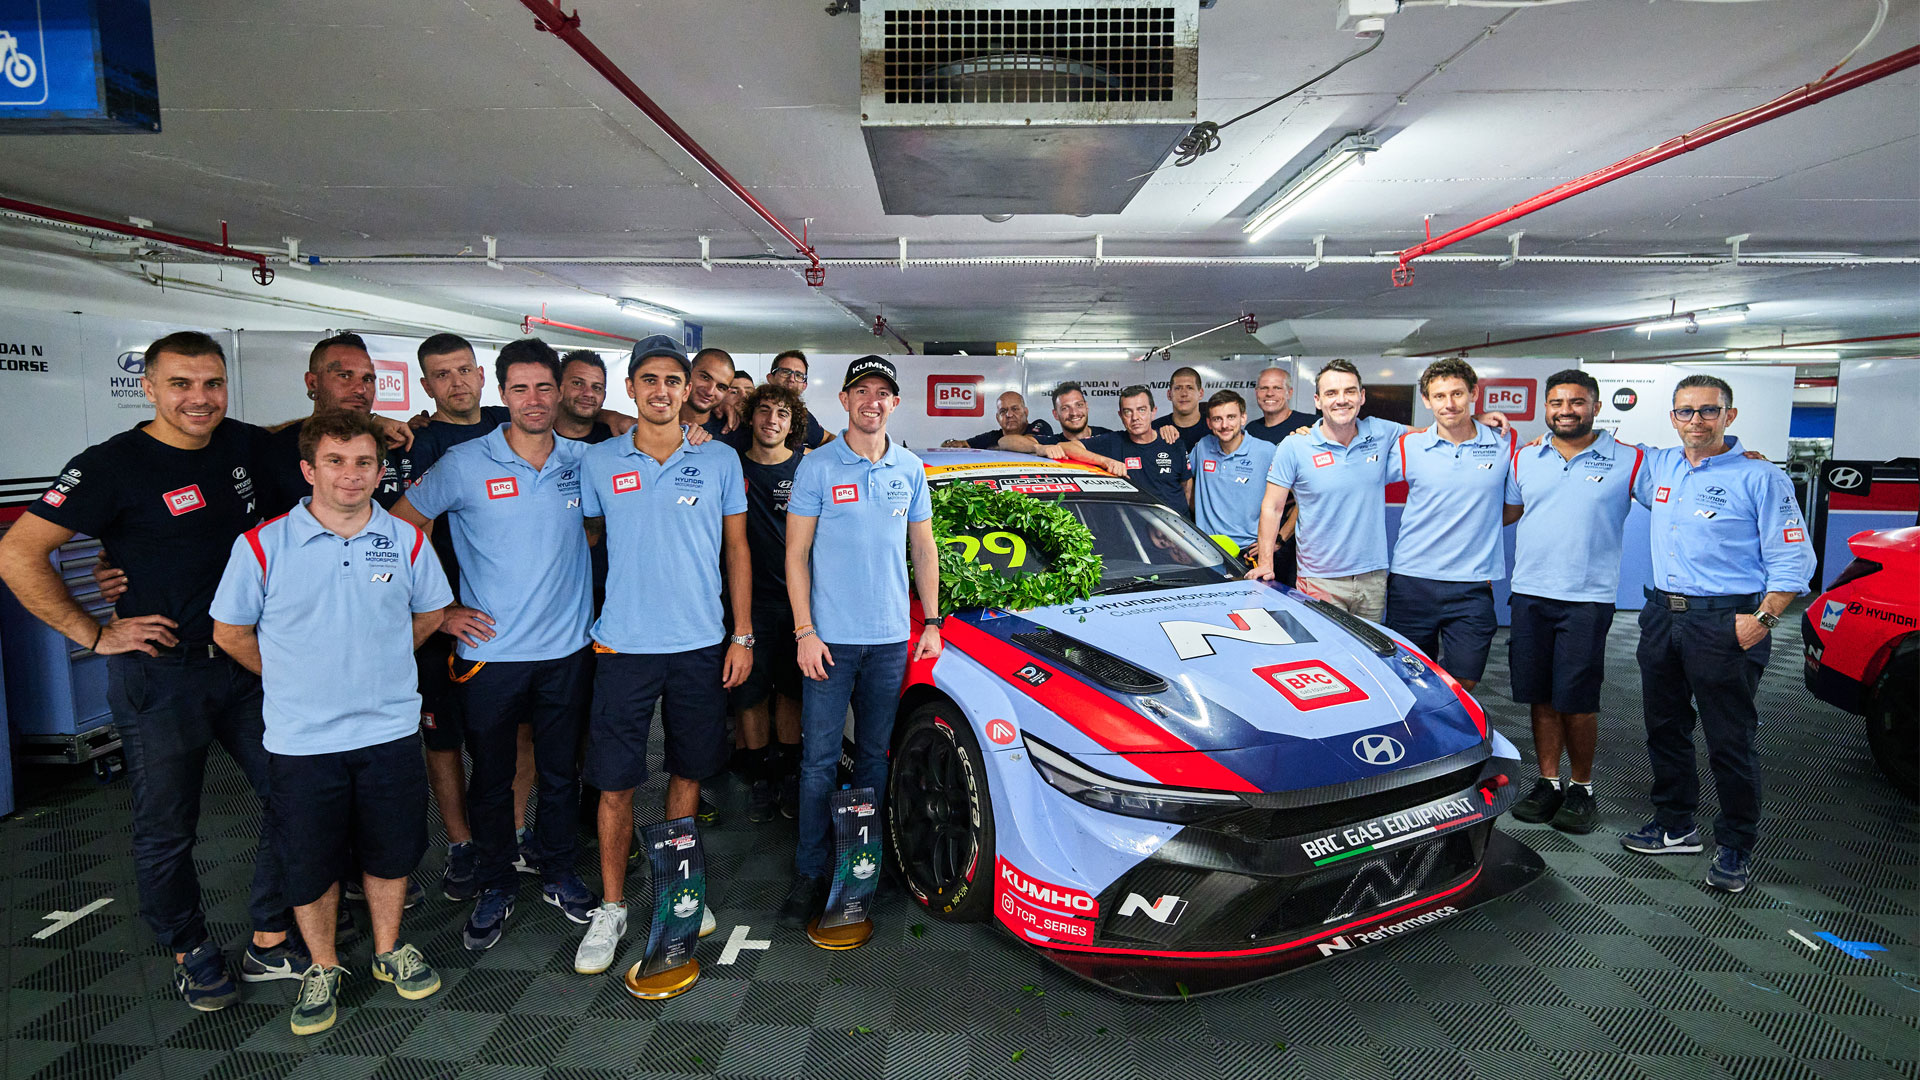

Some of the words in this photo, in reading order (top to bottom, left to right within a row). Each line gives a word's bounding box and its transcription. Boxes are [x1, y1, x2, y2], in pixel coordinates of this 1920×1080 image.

[31, 346, 43, 356] N
[0, 360, 49, 372] CORSE
[852, 361, 894, 377] KUMHO
[379, 375, 401, 391] BRC
[940, 387, 972, 401] BRC
[1488, 390, 1523, 404] BRC
[493, 483, 511, 492] BRC
[618, 478, 635, 486] BRC
[675, 477, 704, 485] HYUNDAI
[175, 493, 196, 505] BRC
[837, 489, 853, 497] BRC
[945, 531, 1027, 572] 29
[1095, 596, 1171, 611] HYUNDAI
[1169, 590, 1262, 602] MOTORSPORT
[1110, 603, 1178, 617] Customer
[1177, 600, 1227, 610] Racing
[1865, 607, 1918, 628] HYUNDAI
[1285, 673, 1333, 690] BRC
[858, 825, 868, 845] 1
[1301, 834, 1345, 860] BRC
[1342, 822, 1385, 848] GAS
[1383, 797, 1476, 834] EQUIPMENT
[677, 858, 690, 880] 1
[1002, 863, 1094, 912] KUMHO
[1117, 892, 1189, 926] N
[1015, 905, 1088, 938] TCR_SERIES
[1354, 904, 1460, 944] Performance
